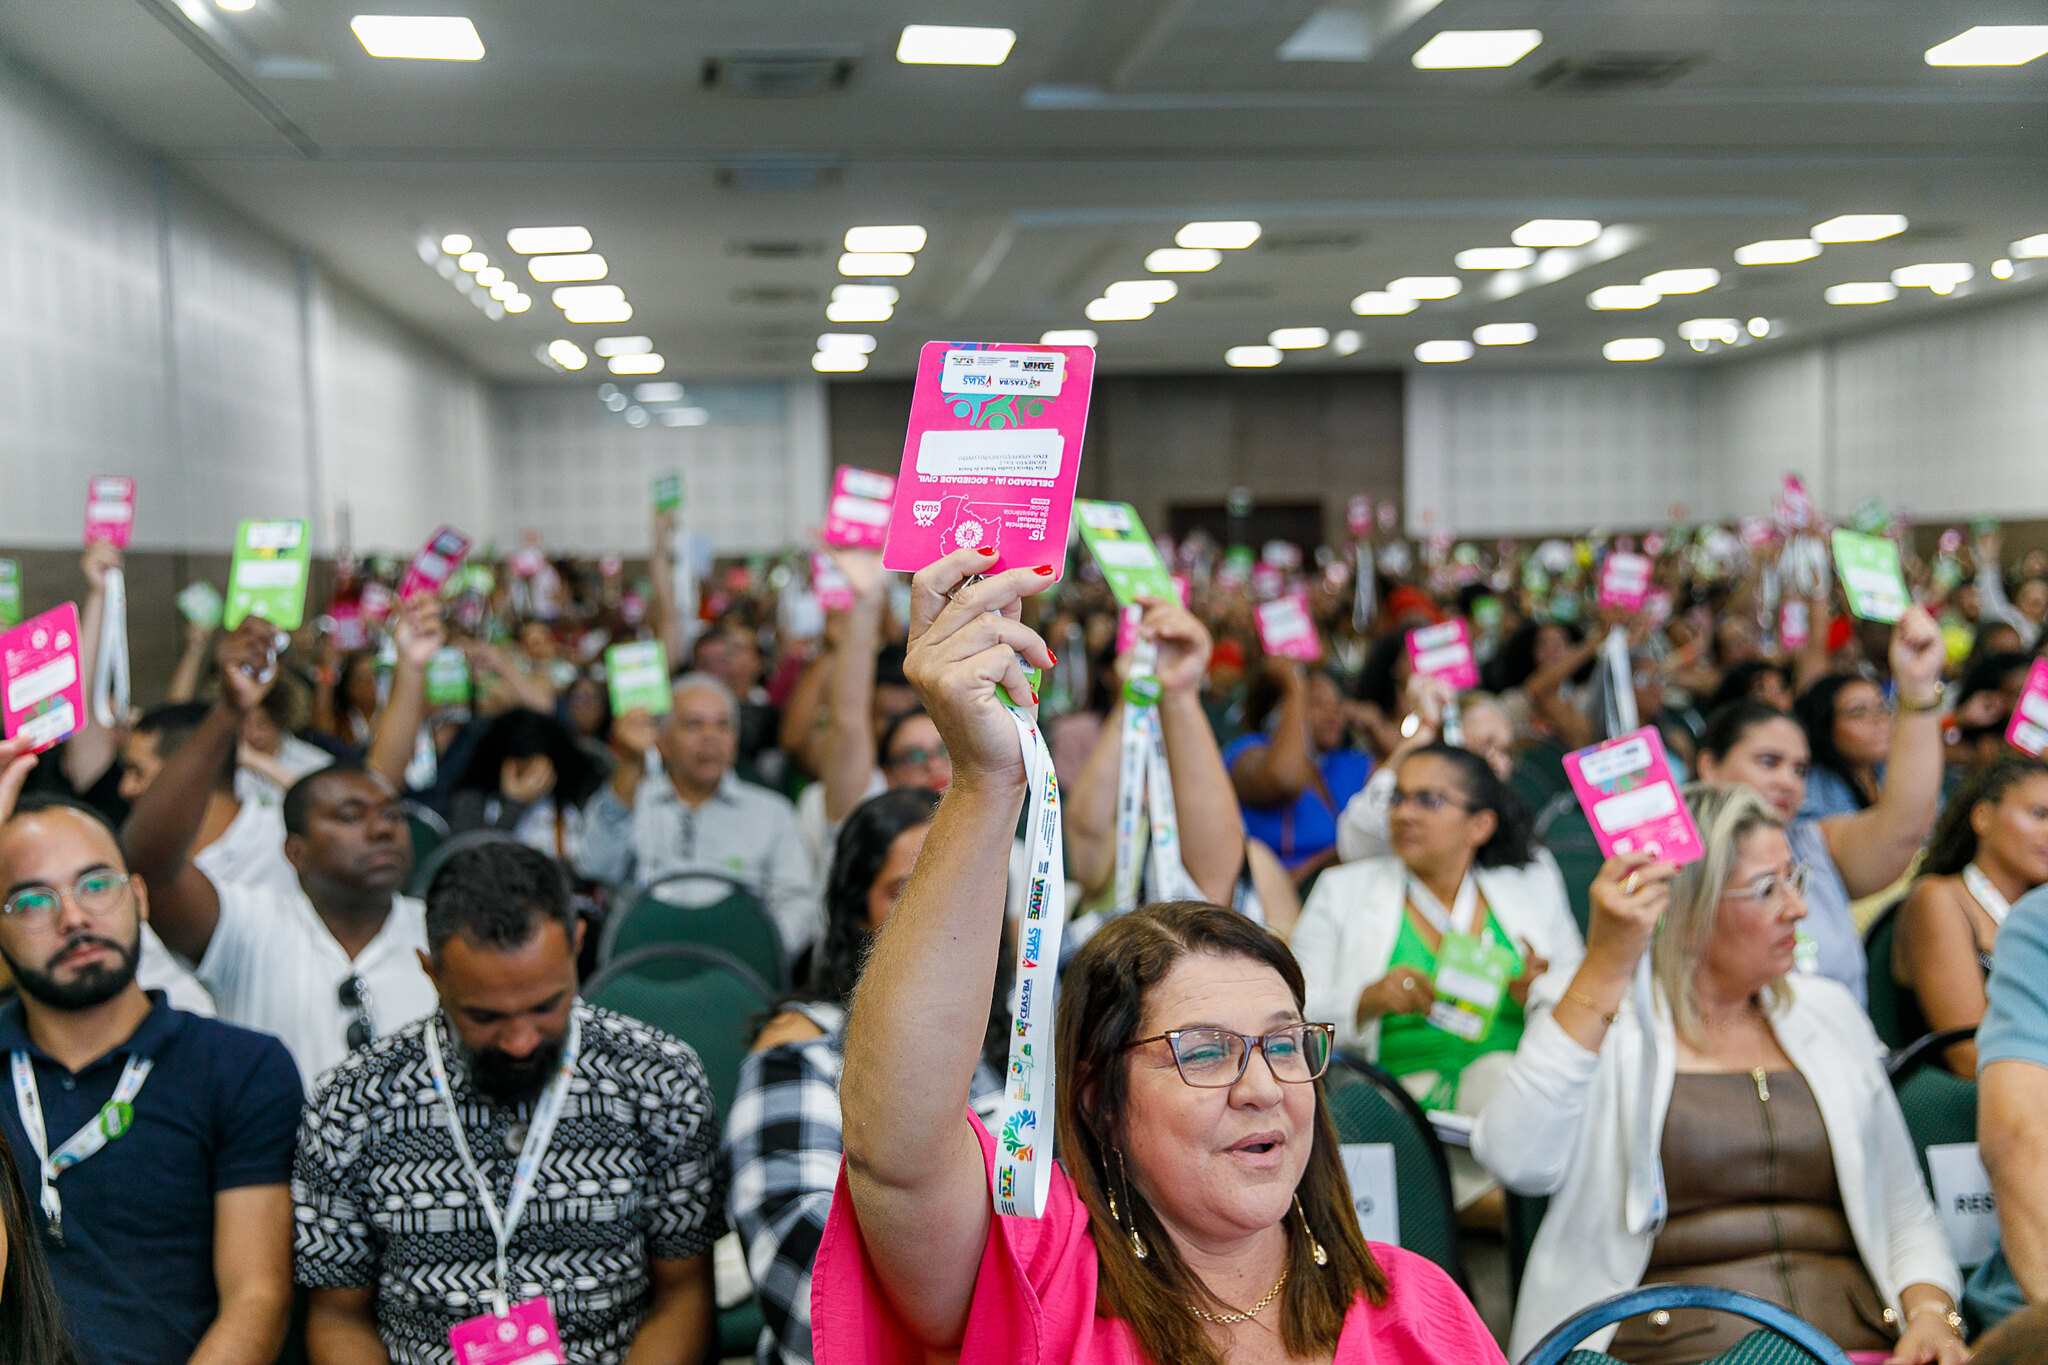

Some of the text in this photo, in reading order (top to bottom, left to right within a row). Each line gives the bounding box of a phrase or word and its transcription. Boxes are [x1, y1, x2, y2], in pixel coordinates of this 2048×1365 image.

[963, 377, 986, 387] SUAS
[999, 379, 1028, 387] CEAS/BA
[918, 475, 938, 483] CIVIL
[940, 476, 989, 485] SOCIEDADE
[995, 476, 1007, 485] (A)
[1007, 478, 1055, 487] DELEGADO
[914, 504, 939, 513] SUAS
[1017, 517, 1047, 525] Estadual
[1025, 928, 1039, 960] SUAS
[1020, 979, 1031, 1019] CEAS/BA
